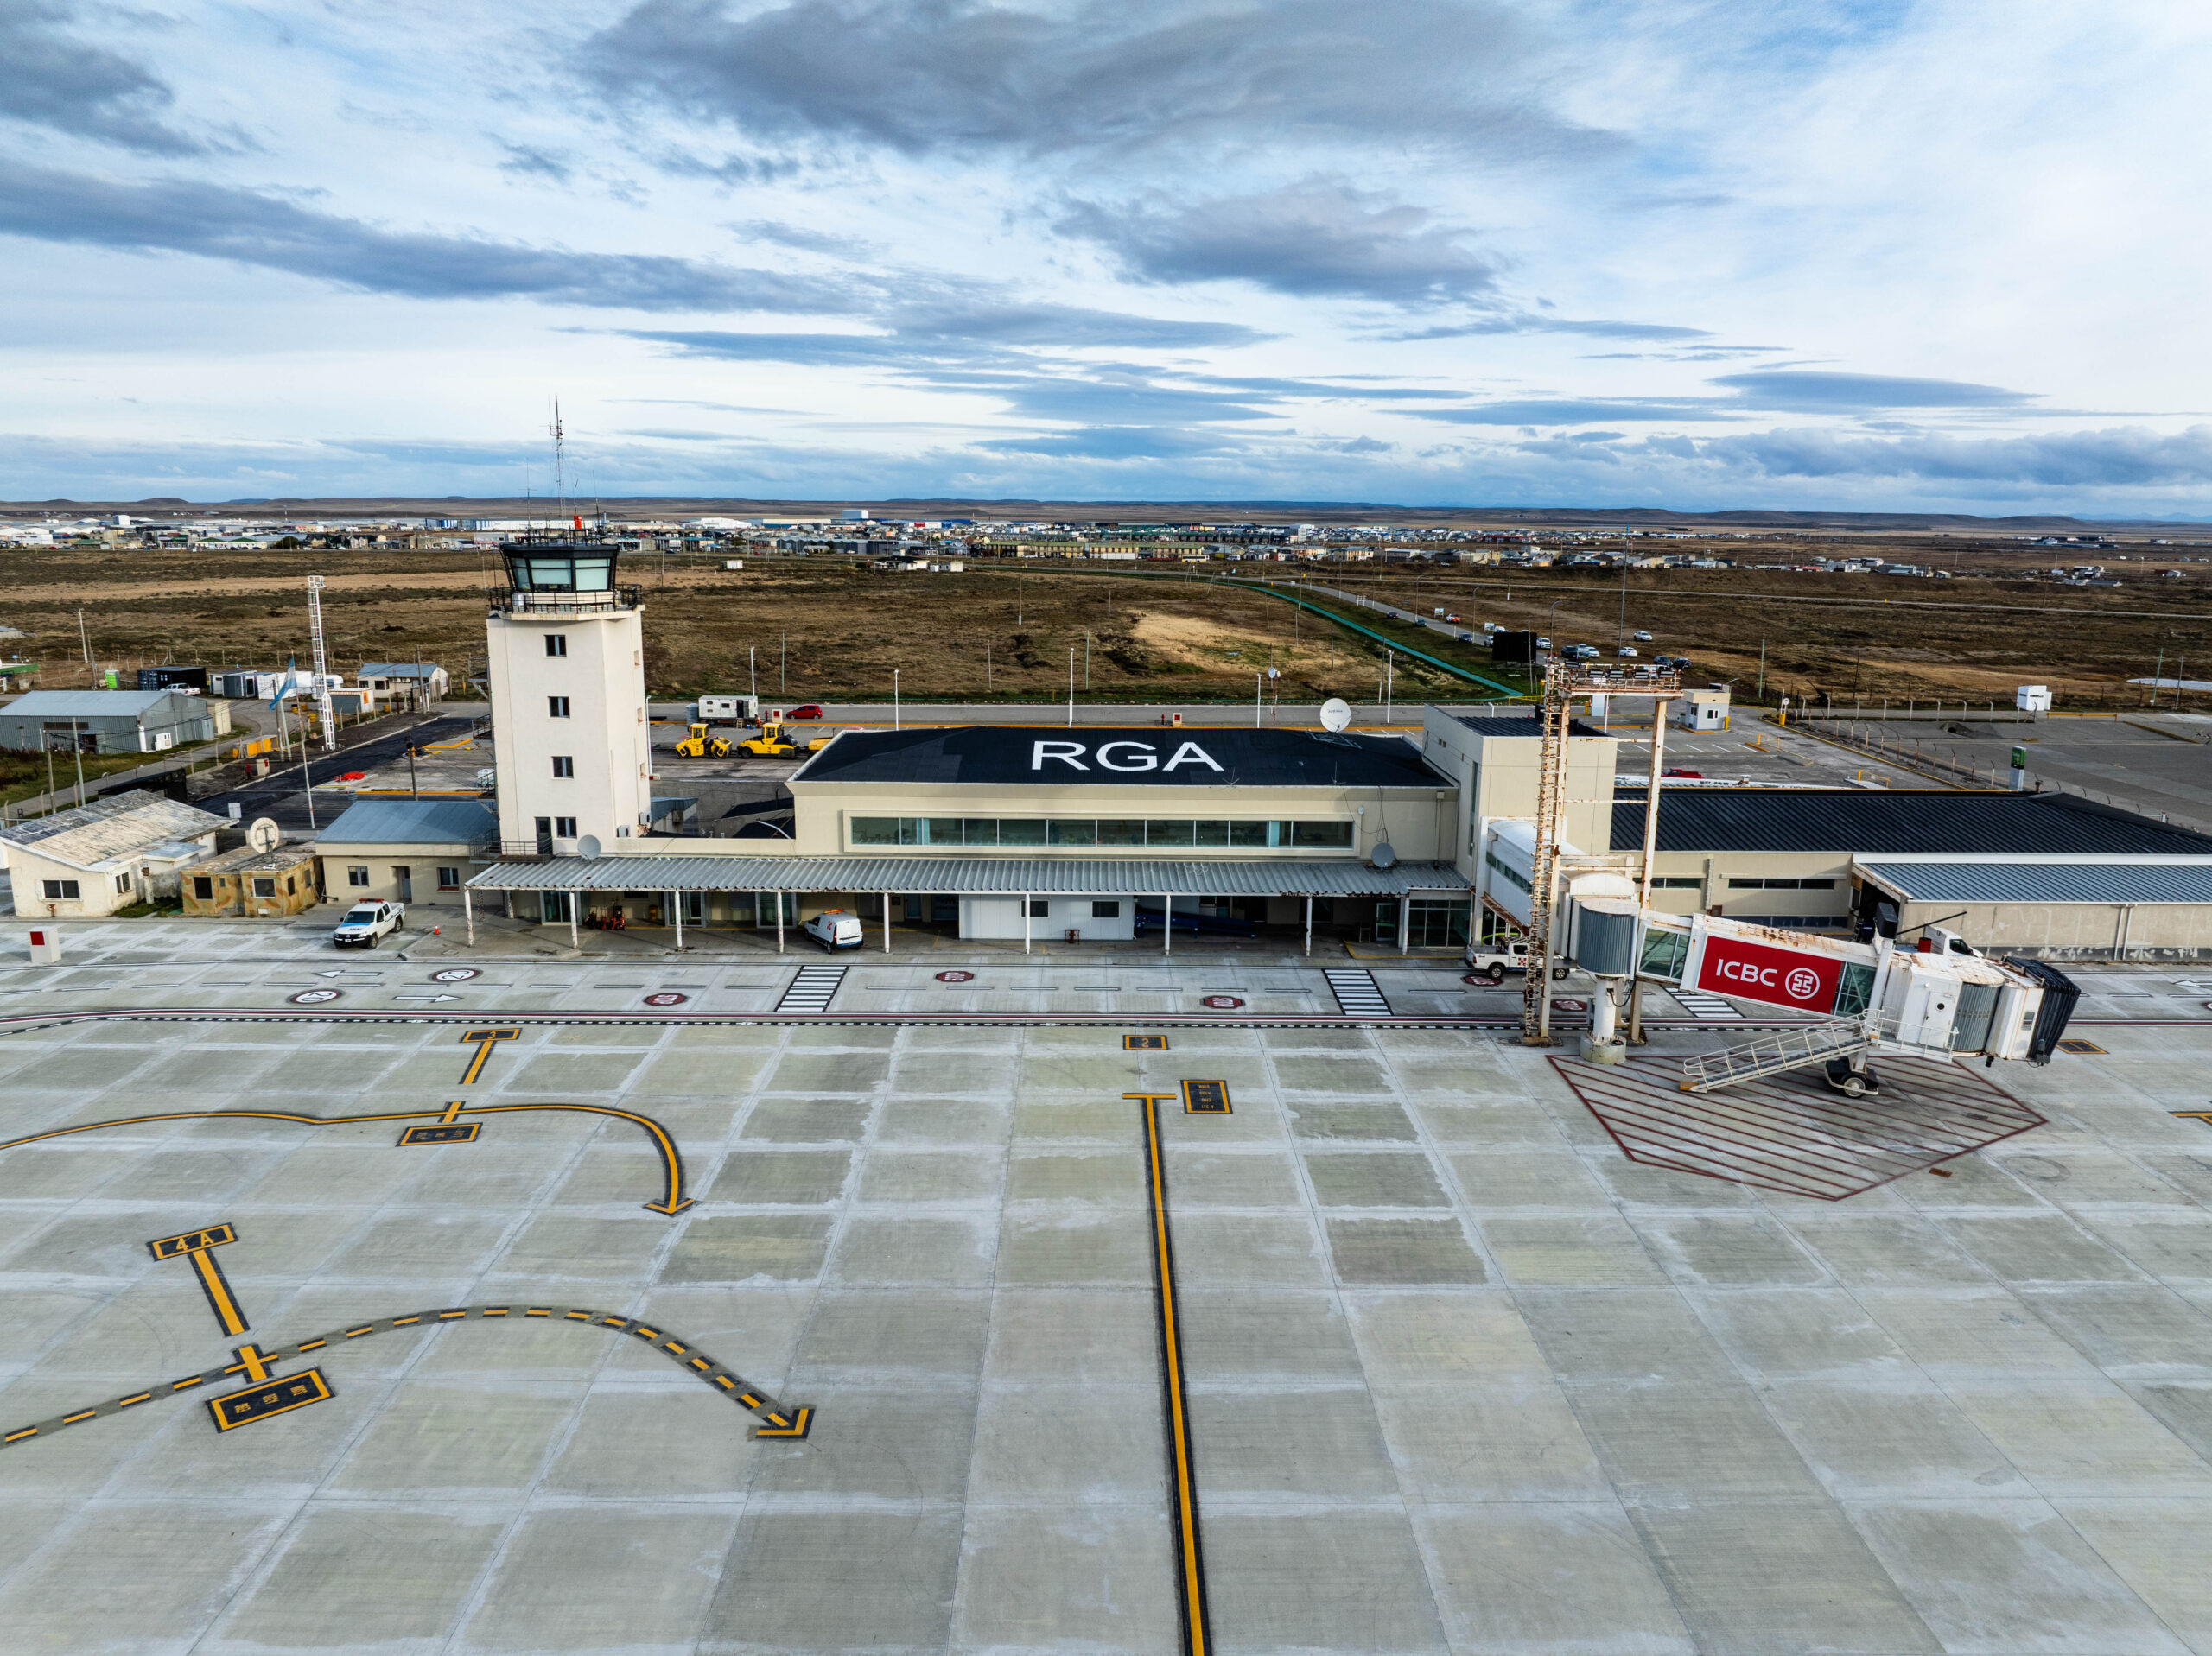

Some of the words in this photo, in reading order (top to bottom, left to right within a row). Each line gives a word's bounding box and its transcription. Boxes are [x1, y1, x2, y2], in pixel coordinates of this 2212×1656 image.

[1032, 741, 1224, 771] RGA
[1716, 959, 1777, 987] ICBC
[486, 1031, 496, 1039] 3
[1141, 1037, 1149, 1047] 2
